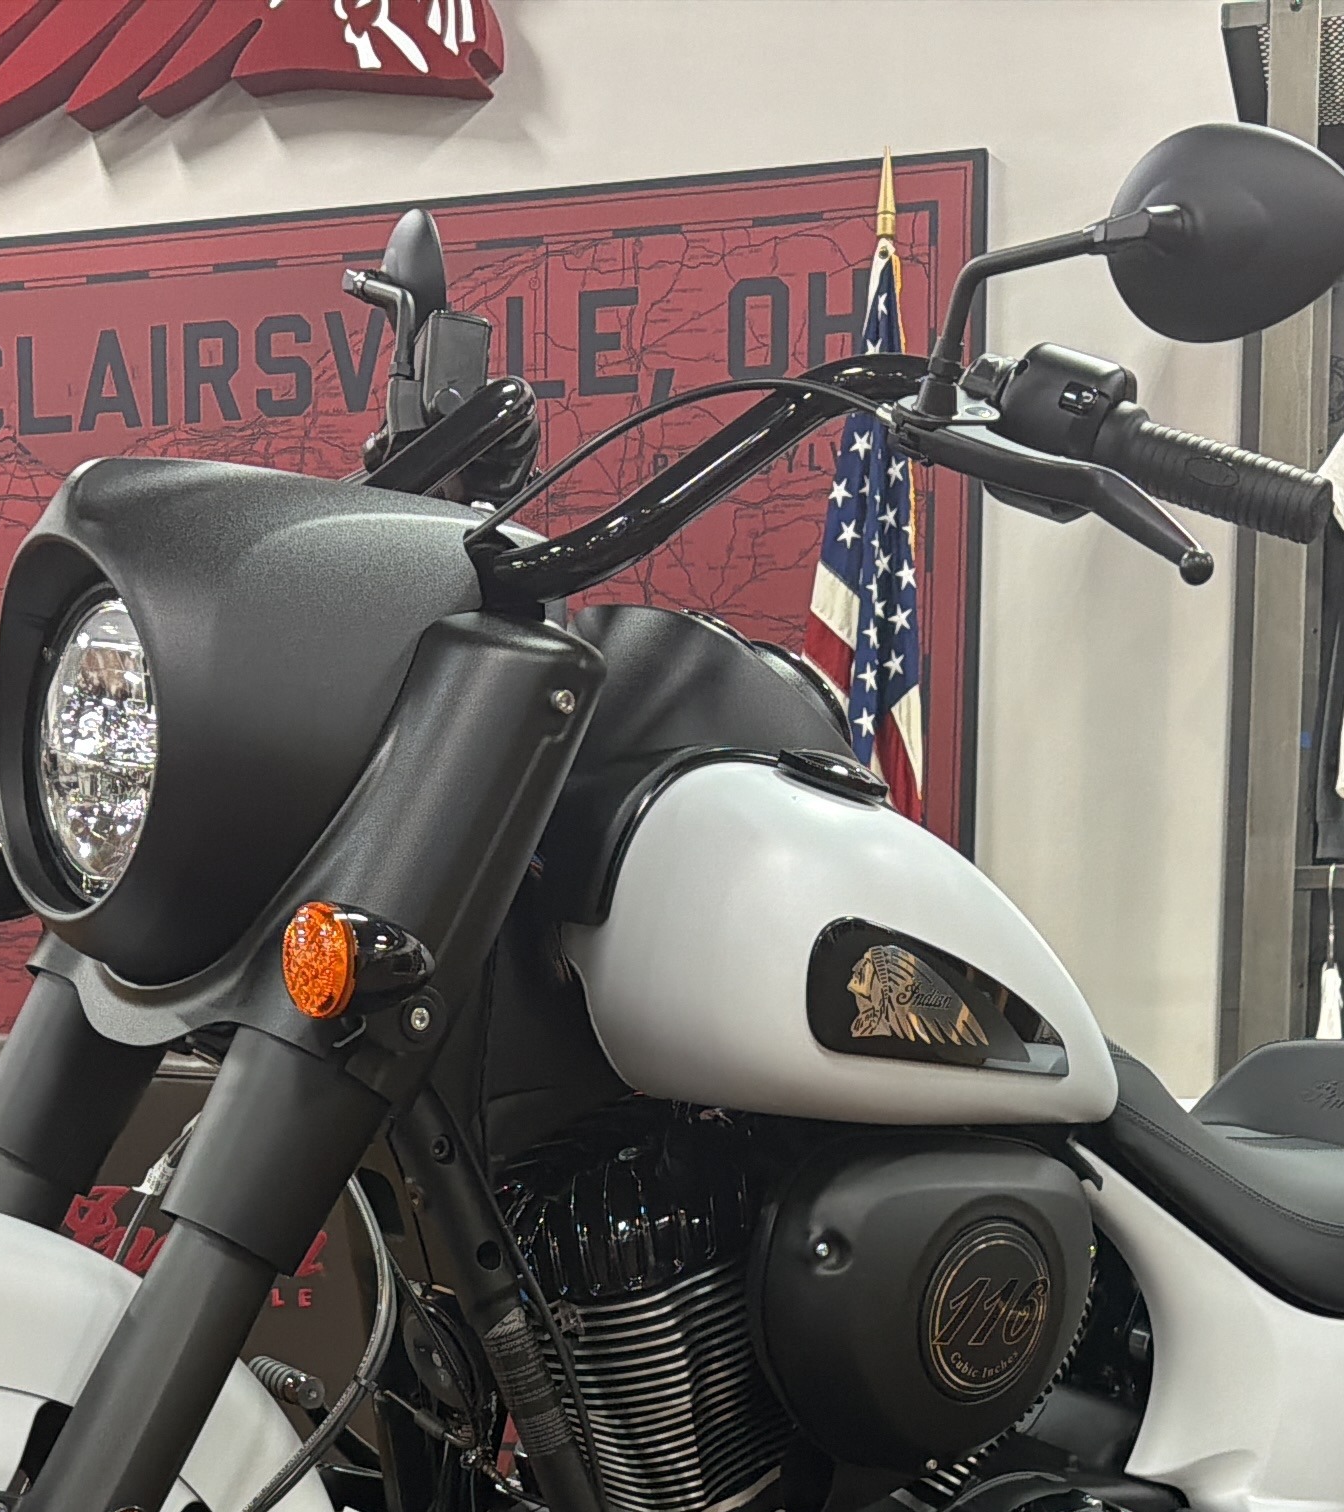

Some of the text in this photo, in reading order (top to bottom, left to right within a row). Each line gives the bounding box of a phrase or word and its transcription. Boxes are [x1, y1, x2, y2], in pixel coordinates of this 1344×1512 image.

[728, 268, 870, 379] OH
[896, 979, 953, 1010] Indian
[932, 1276, 1050, 1346] 116
[950, 1351, 1019, 1379] Cubic Inches
